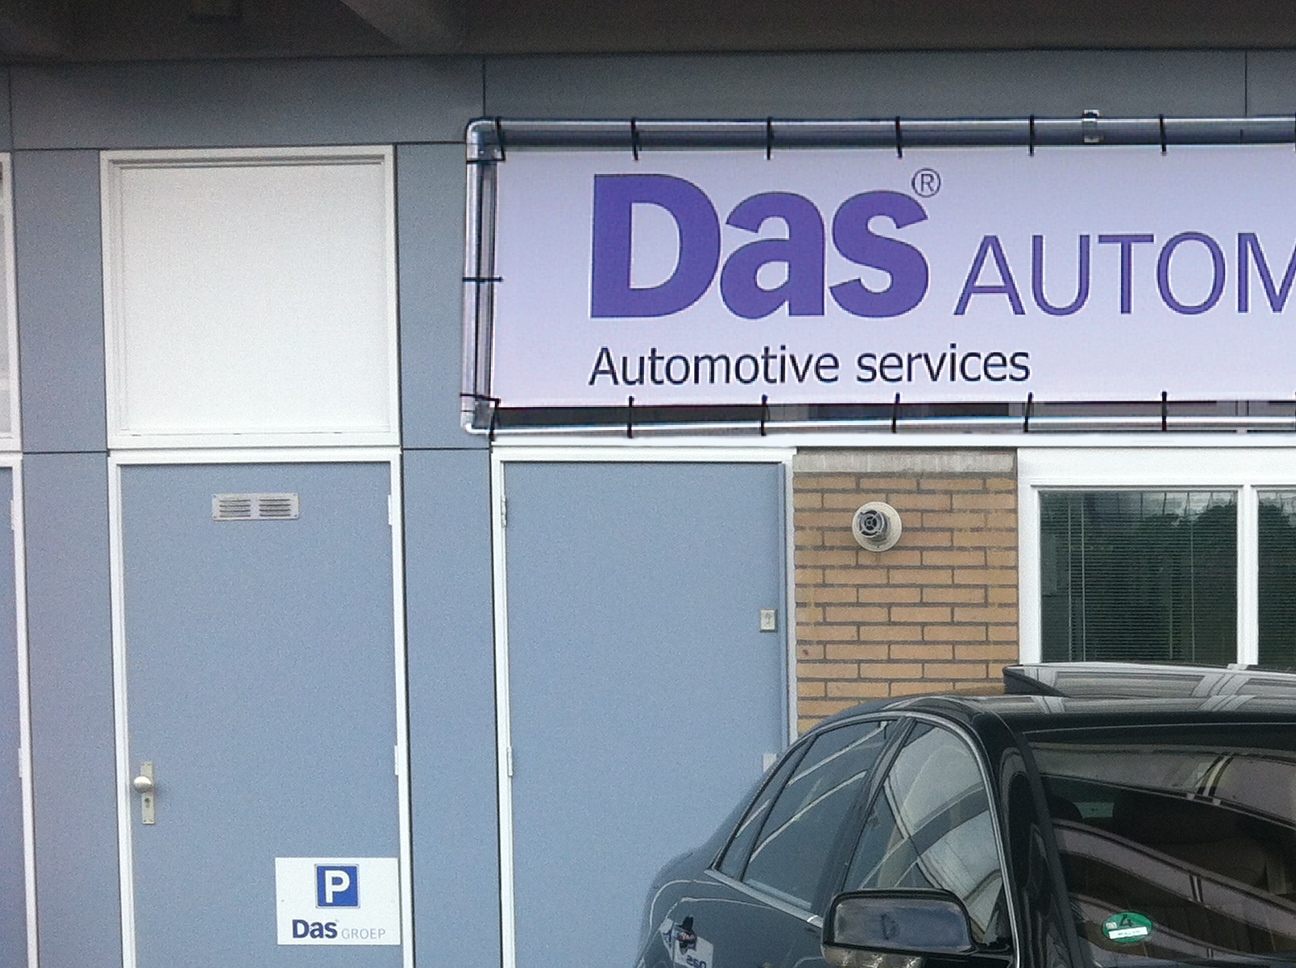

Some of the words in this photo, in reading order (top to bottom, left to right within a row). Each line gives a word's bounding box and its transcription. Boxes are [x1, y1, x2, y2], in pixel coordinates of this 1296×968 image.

[588, 344, 839, 387] Automotive
[856, 343, 1031, 384] services
[325, 870, 350, 903] P
[292, 919, 338, 939] Das
[341, 928, 386, 940] GROEP
